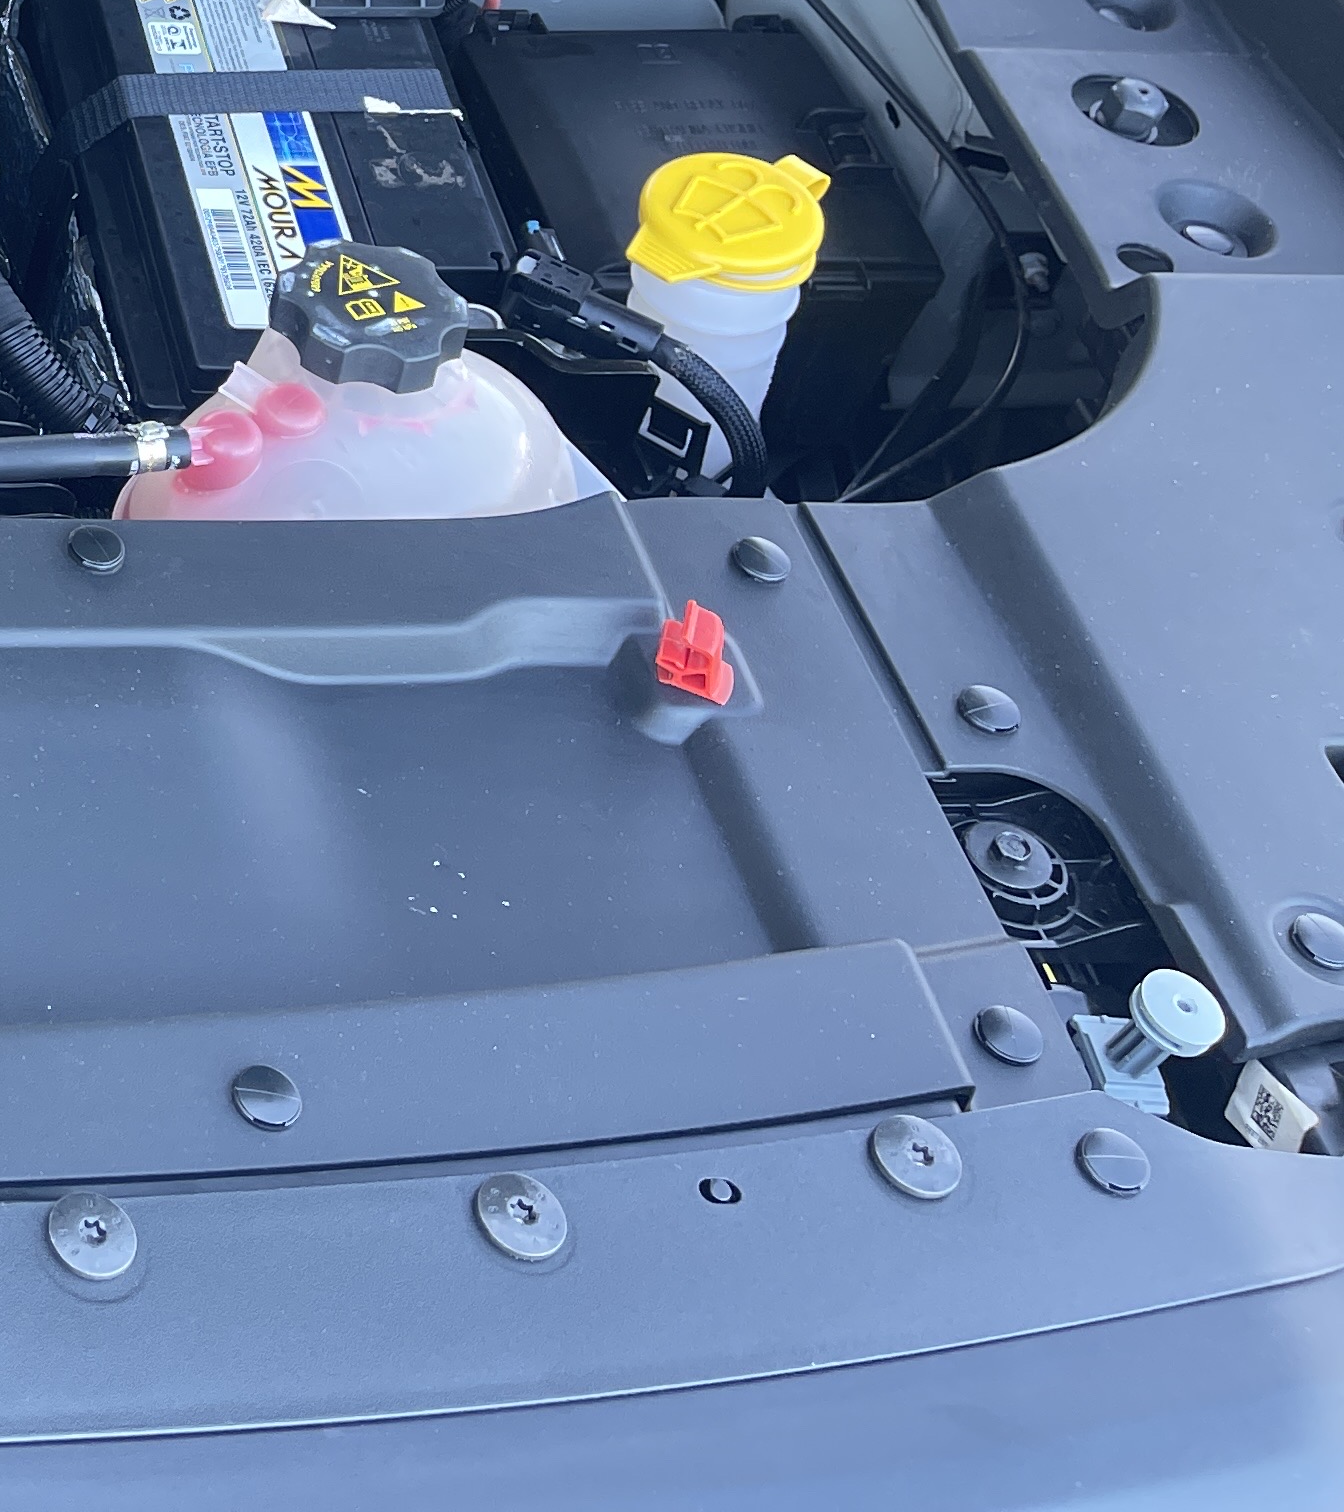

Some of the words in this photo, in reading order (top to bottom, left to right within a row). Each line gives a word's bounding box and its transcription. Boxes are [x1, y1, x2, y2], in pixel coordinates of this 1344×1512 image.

[192, 114, 213, 159] ECNOLOGIA
[204, 114, 235, 177] TART-STOP
[235, 189, 251, 207] 12V
[241, 209, 257, 232] 72Ah
[252, 164, 304, 260] MOURA
[250, 234, 265, 257] 420A
[257, 260, 271, 275] IEC
